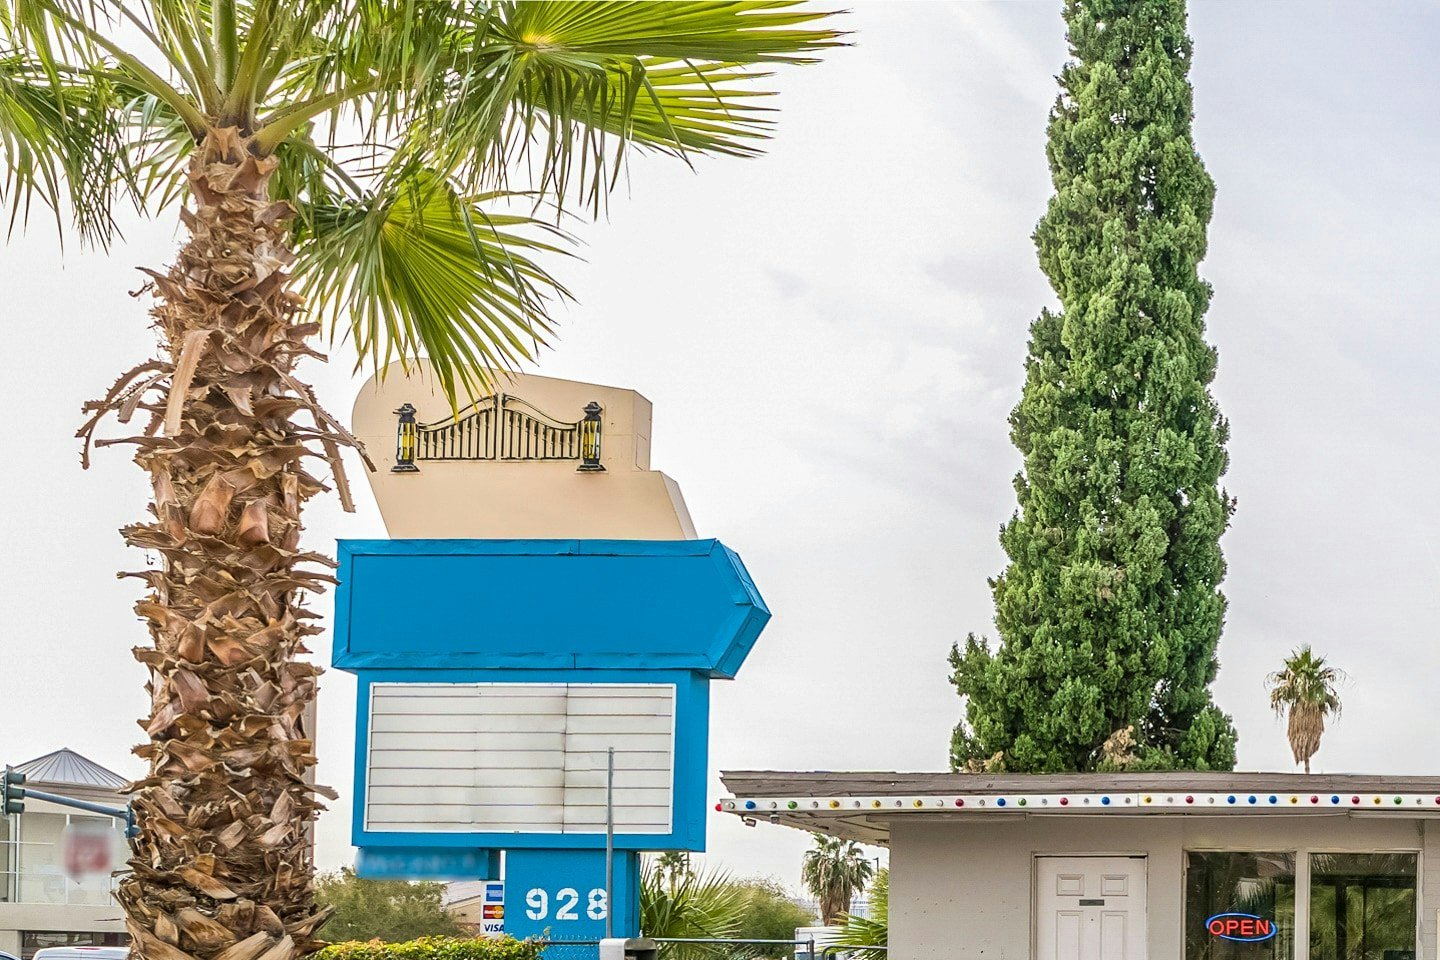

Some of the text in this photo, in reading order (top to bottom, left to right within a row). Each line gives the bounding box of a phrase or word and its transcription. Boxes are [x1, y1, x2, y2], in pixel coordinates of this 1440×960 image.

[526, 888, 607, 920] 928
[484, 924, 504, 932] VISA
[1209, 920, 1269, 936] OPEN
